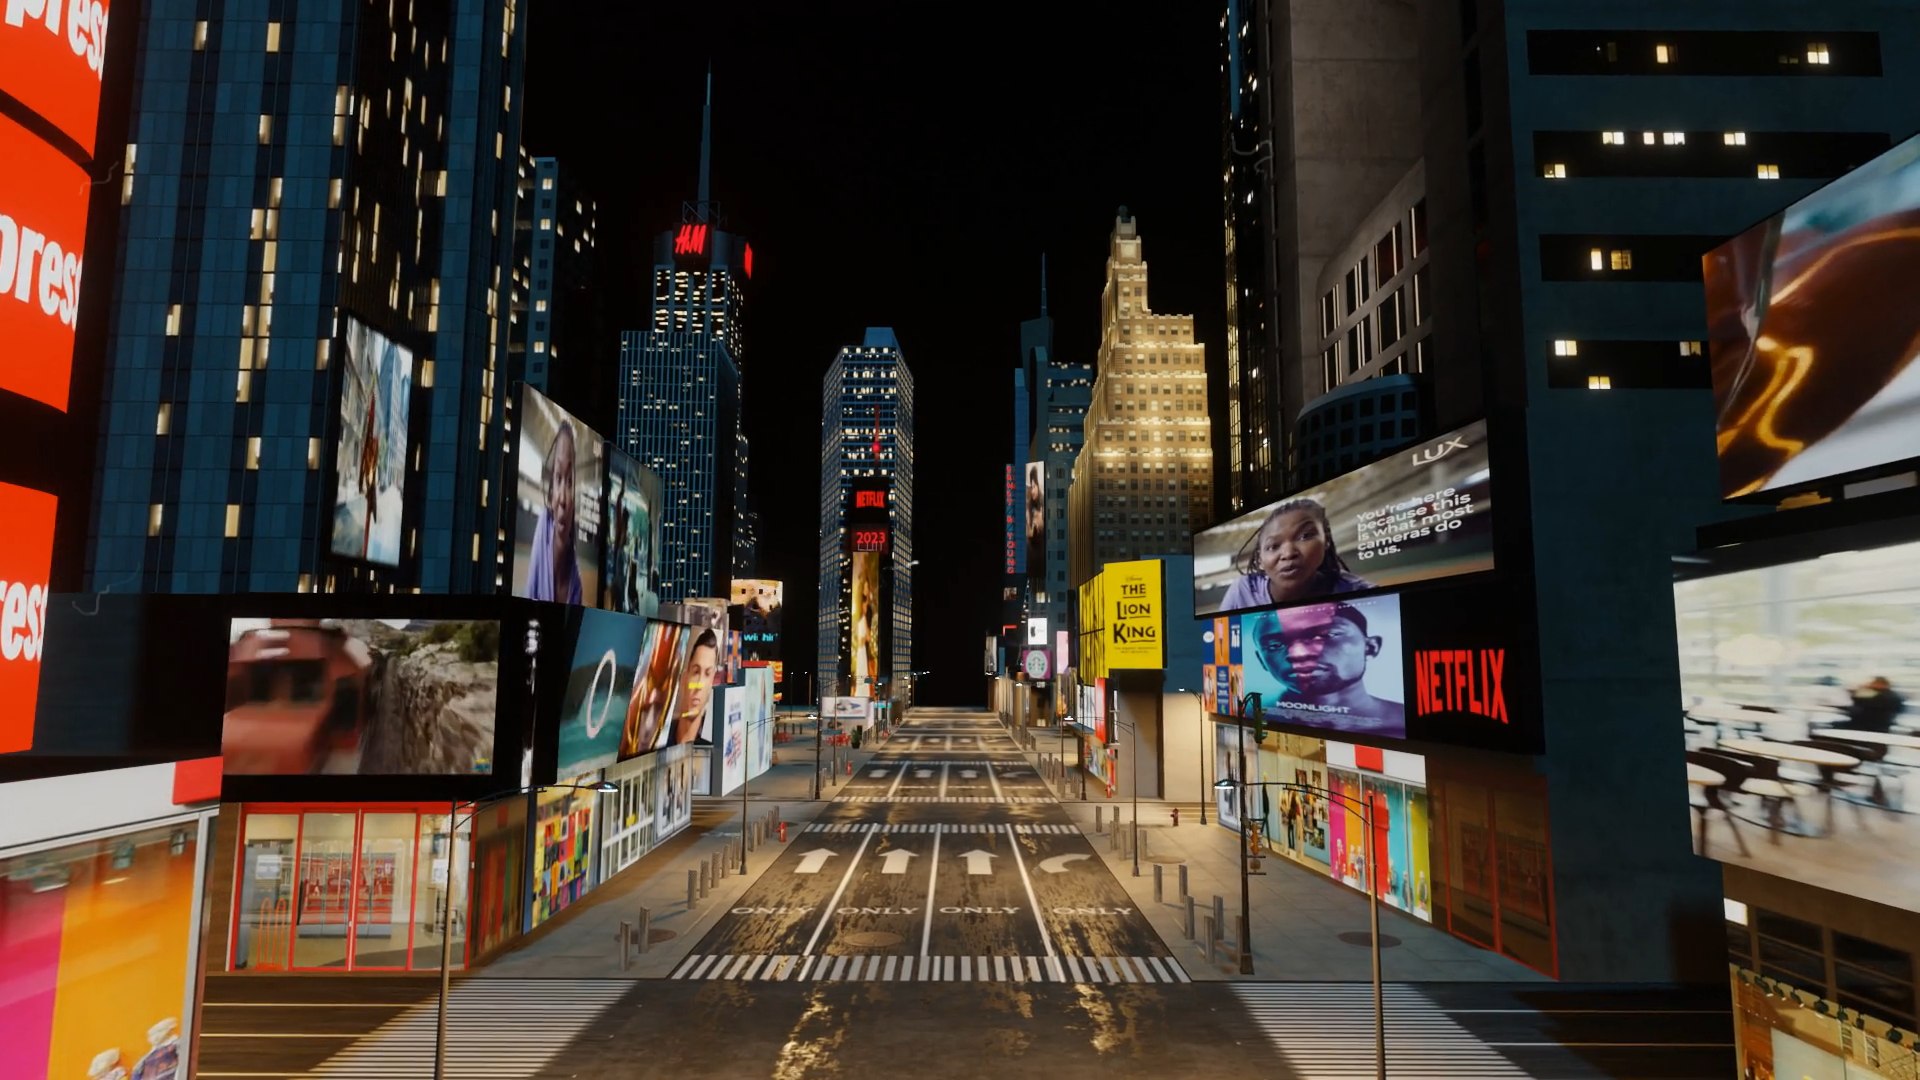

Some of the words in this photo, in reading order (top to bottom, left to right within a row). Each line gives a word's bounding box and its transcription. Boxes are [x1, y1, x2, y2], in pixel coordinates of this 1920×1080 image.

[1412, 436, 1469, 467] LUX
[1357, 503, 1407, 521] You're
[1412, 487, 1456, 506] here
[1357, 506, 1428, 532] because
[1432, 493, 1472, 512] this
[1373, 519, 1417, 537] what
[1422, 504, 1474, 525] most
[856, 531, 886, 544] 2023
[1357, 526, 1431, 551] cameras
[1435, 519, 1462, 533] do
[1357, 550, 1375, 561] to
[1378, 545, 1401, 556] us.
[1121, 584, 1146, 595] THE
[1117, 601, 1151, 620] LION
[1113, 623, 1156, 644] KING
[1415, 649, 1509, 725] NETFLIX
[1276, 700, 1351, 714] MOONLIGHT
[731, 907, 816, 915] ONLY
[836, 907, 920, 915] ONLY
[939, 906, 1021, 914] ONLY
[1052, 907, 1133, 915] ONLY
